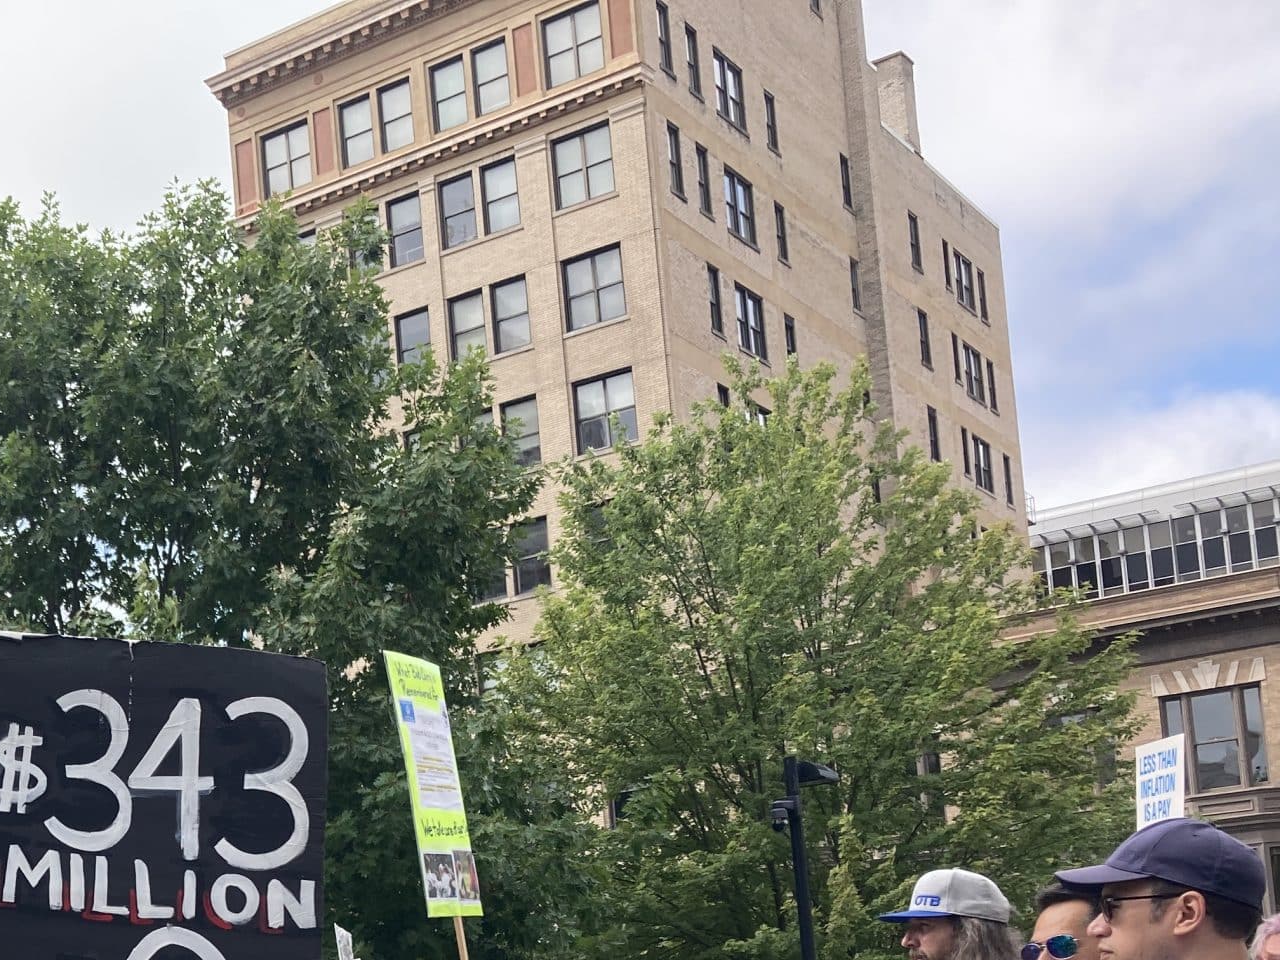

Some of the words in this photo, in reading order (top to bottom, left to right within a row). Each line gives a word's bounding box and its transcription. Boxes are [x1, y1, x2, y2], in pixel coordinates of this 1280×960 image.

[1140, 754, 1156, 776] LESS
[1158, 747, 1177, 771] THAN
[1140, 772, 1176, 799] INFLATION
[1144, 804, 1151, 822] IS
[1152, 802, 1157, 820] A
[1158, 799, 1171, 818] PAY
[1, 844, 318, 931] MILLION
